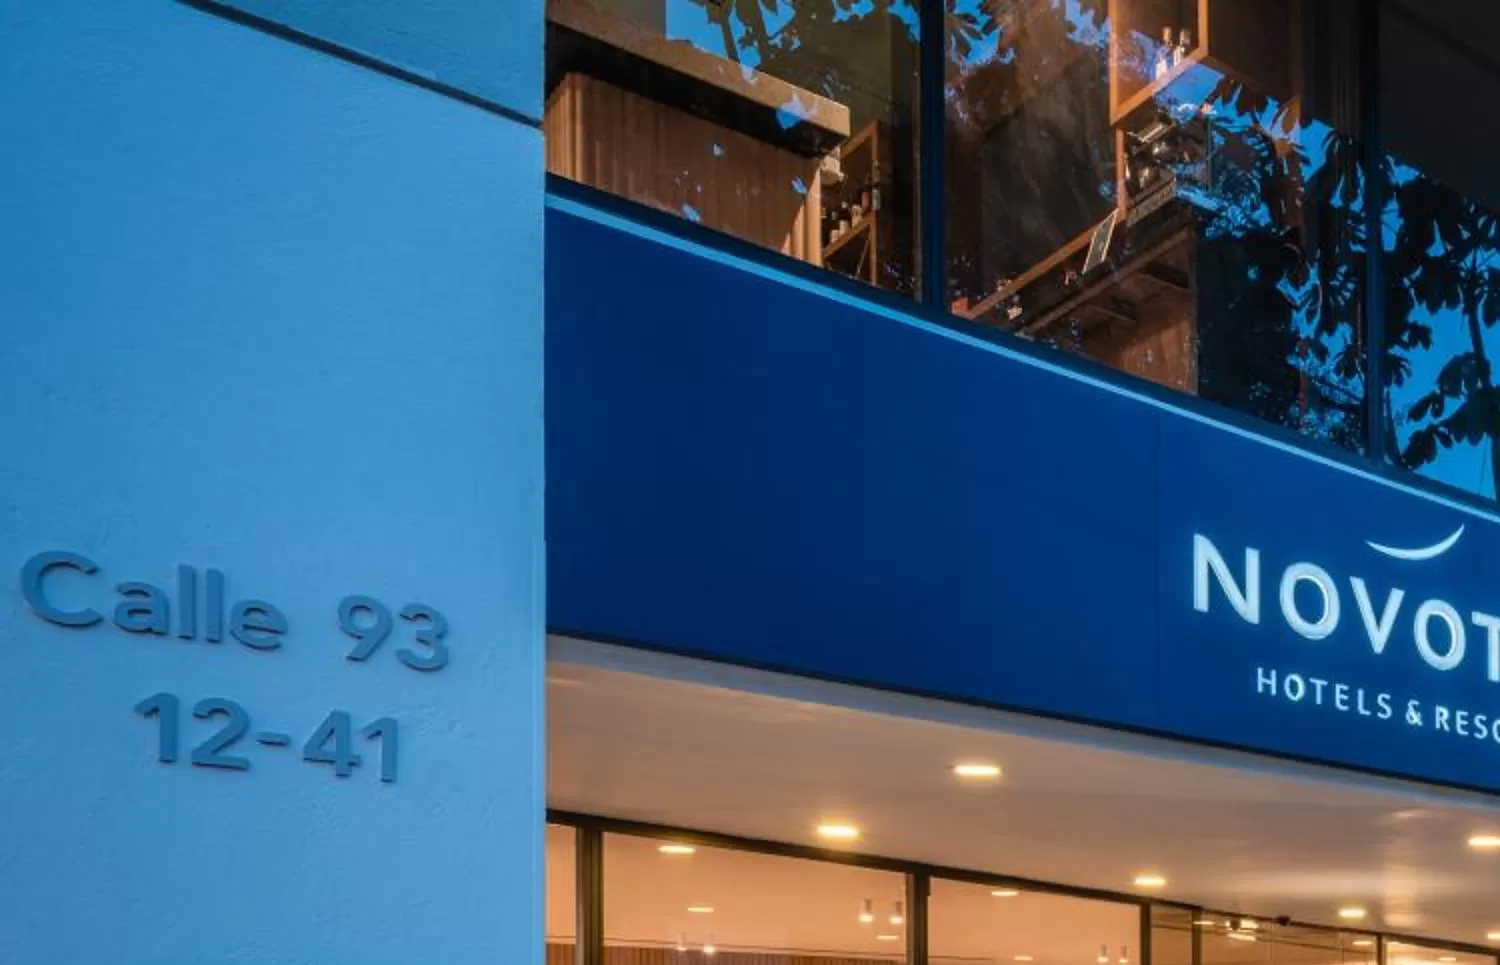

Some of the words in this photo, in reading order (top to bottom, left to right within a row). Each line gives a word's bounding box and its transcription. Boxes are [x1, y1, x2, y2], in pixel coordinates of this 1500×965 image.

[20, 549, 289, 650] Calle
[336, 594, 450, 672] 93
[134, 692, 400, 782] 12-41
[1257, 668, 1392, 719] HOTELS
[1405, 700, 1423, 726] &
